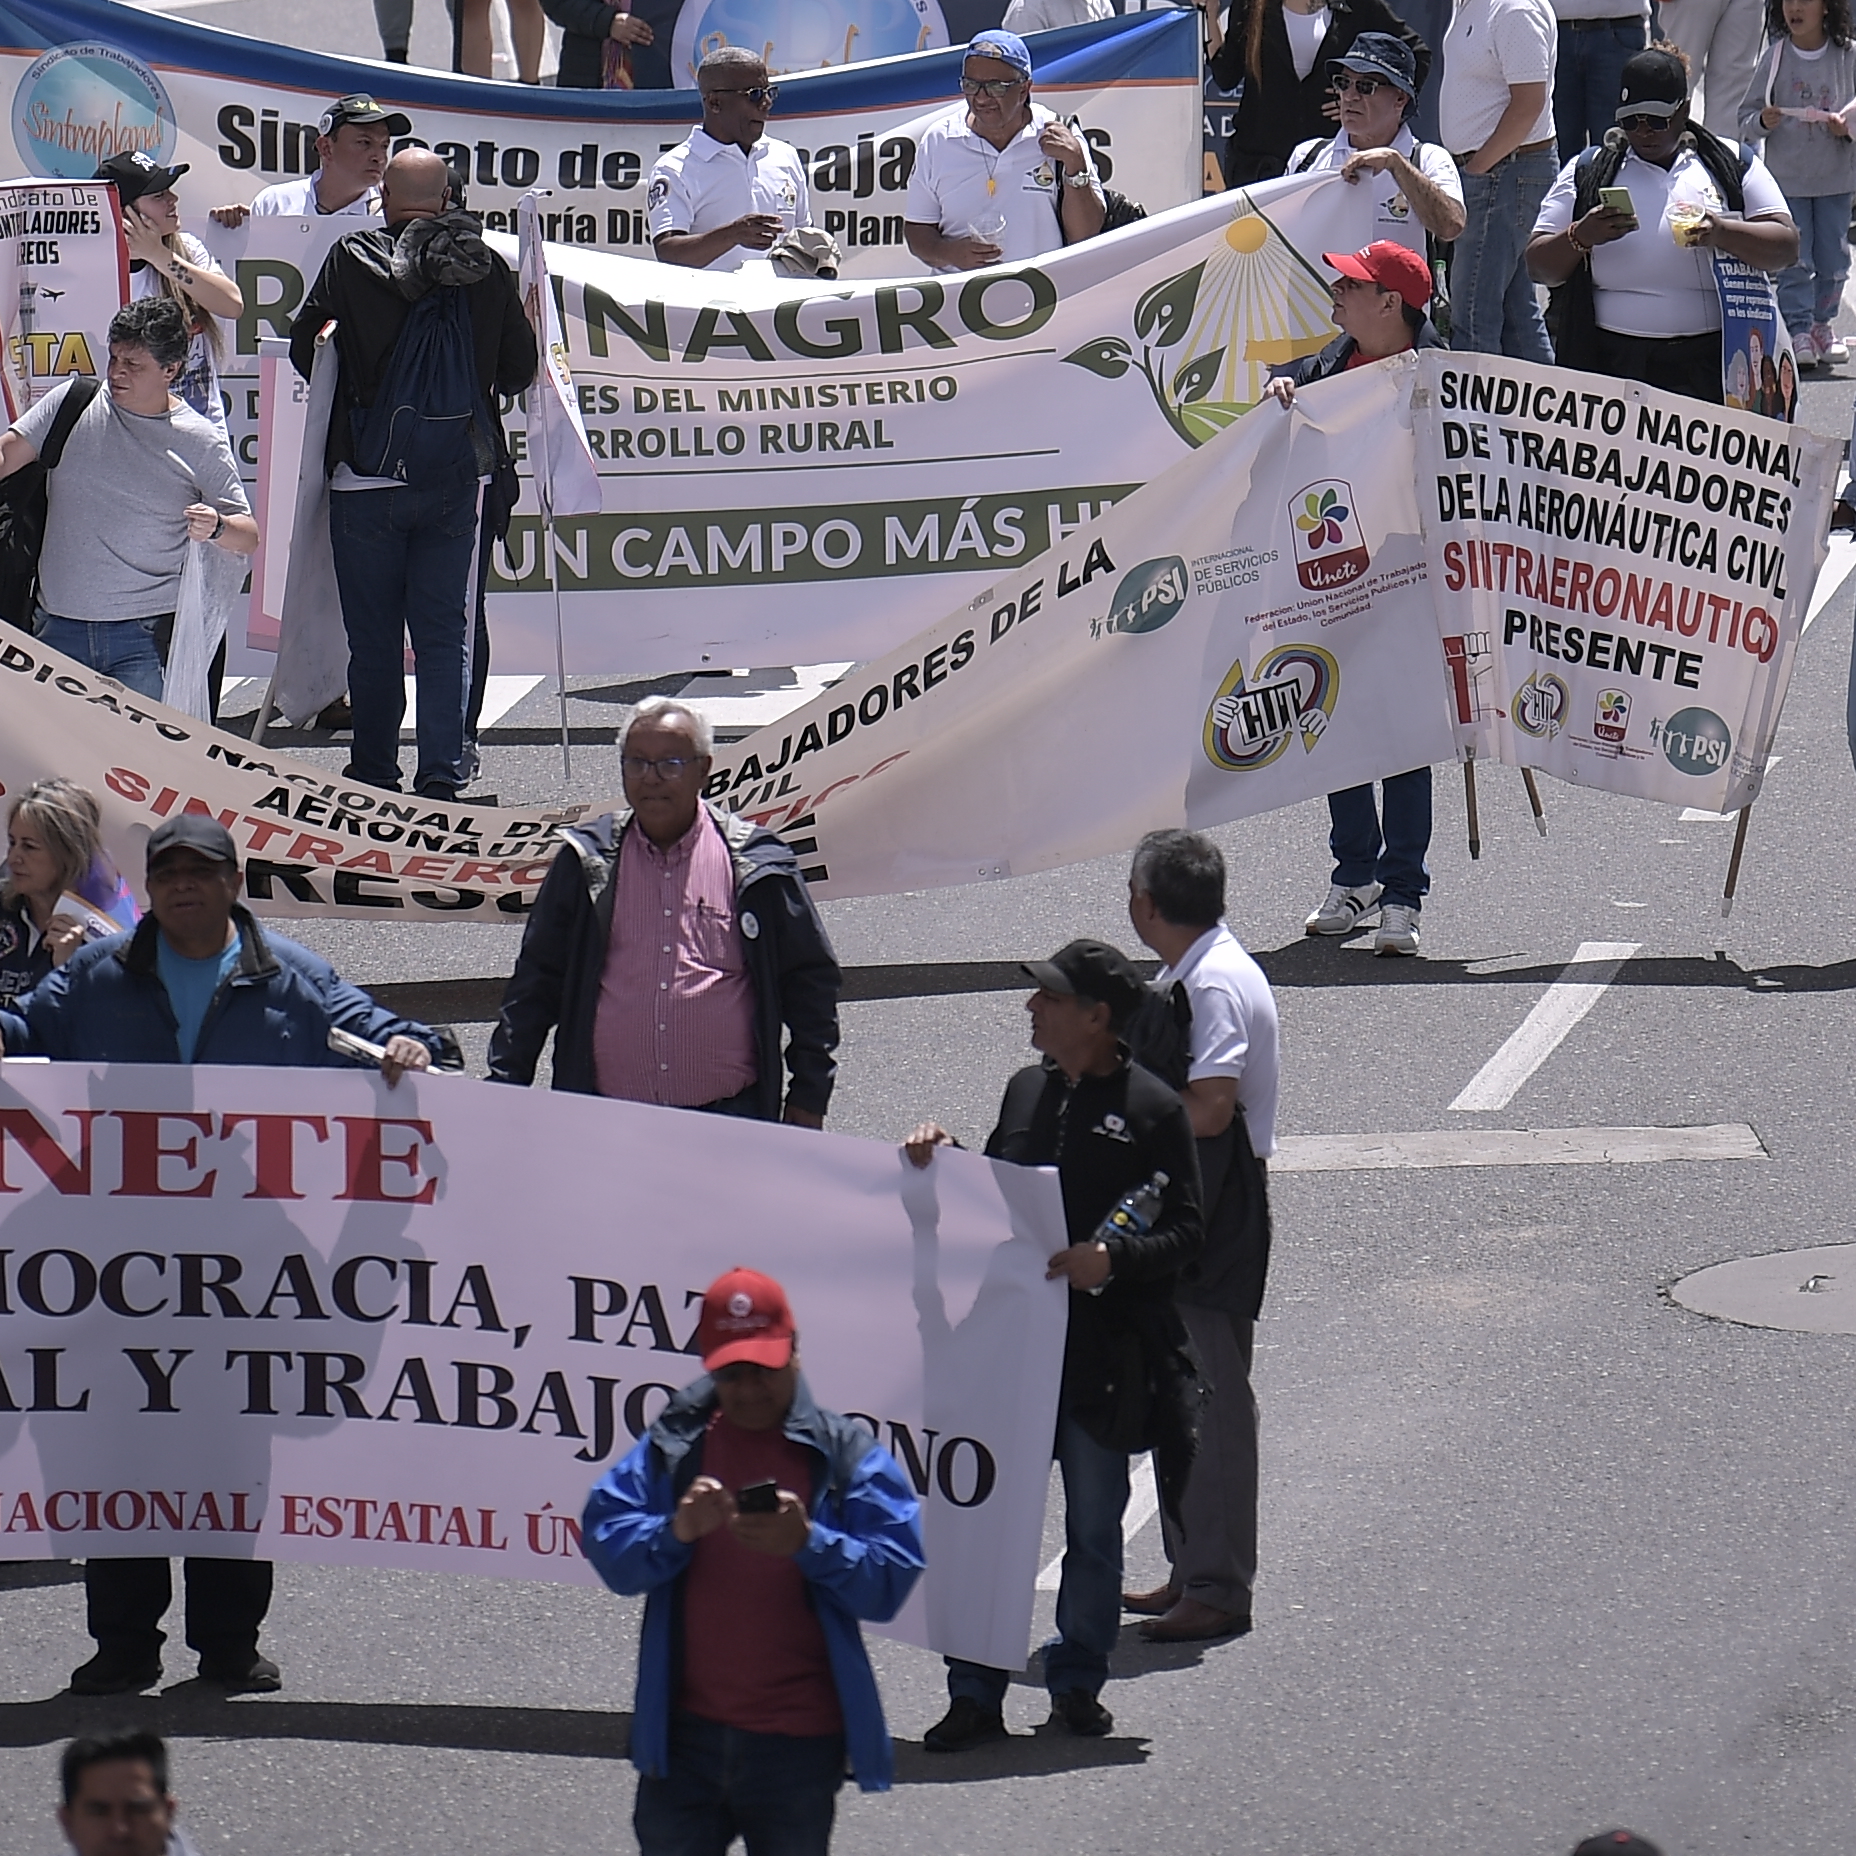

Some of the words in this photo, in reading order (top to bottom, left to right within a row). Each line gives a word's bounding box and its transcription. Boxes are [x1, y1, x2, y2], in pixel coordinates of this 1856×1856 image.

[30, 47, 79, 81] Sindicato
[80, 46, 95, 56] de
[98, 47, 162, 101] Trabajadores
[557, 143, 642, 190] de
[71, 186, 99, 207] De
[631, 384, 708, 415] DEL
[717, 373, 959, 412] MINISTERIO
[759, 419, 895, 456] RURAL
[1439, 369, 1628, 438] SINDICATO
[1635, 404, 1803, 489] NACIONAL
[1442, 420, 1492, 461] DE
[1497, 426, 1794, 537] TRABAJADORES
[491, 528, 591, 582] UN
[612, 516, 863, 579] CAMPO
[884, 497, 1027, 566] MÁS
[1190, 545, 1255, 568] INTERNACIONAL
[1437, 472, 1476, 523] DE
[1477, 473, 1513, 526] LA
[1516, 486, 1720, 576] AERONÁUTICA
[1725, 534, 1789, 601] CIVIL
[1139, 565, 1186, 614] PSI
[1194, 568, 1212, 583] DE
[1214, 549, 1280, 578] SERVICIOS
[1196, 569, 1261, 596] PÚBLICOS
[1306, 560, 1360, 587] Únete
[1261, 619, 1277, 633] del
[1312, 605, 1328, 620] los
[1328, 592, 1370, 615] Servicios
[1325, 585, 1366, 602] Nacional
[1366, 580, 1378, 592] de
[1502, 608, 1706, 692] PRESENTE
[205, 743, 484, 838] NACIONAL
[988, 577, 1045, 647] DE
[1055, 536, 1118, 600] LA
[1690, 734, 1728, 767] PSI
[136, 1347, 196, 1414] Y
[279, 1494, 496, 1550] ESTATAL
